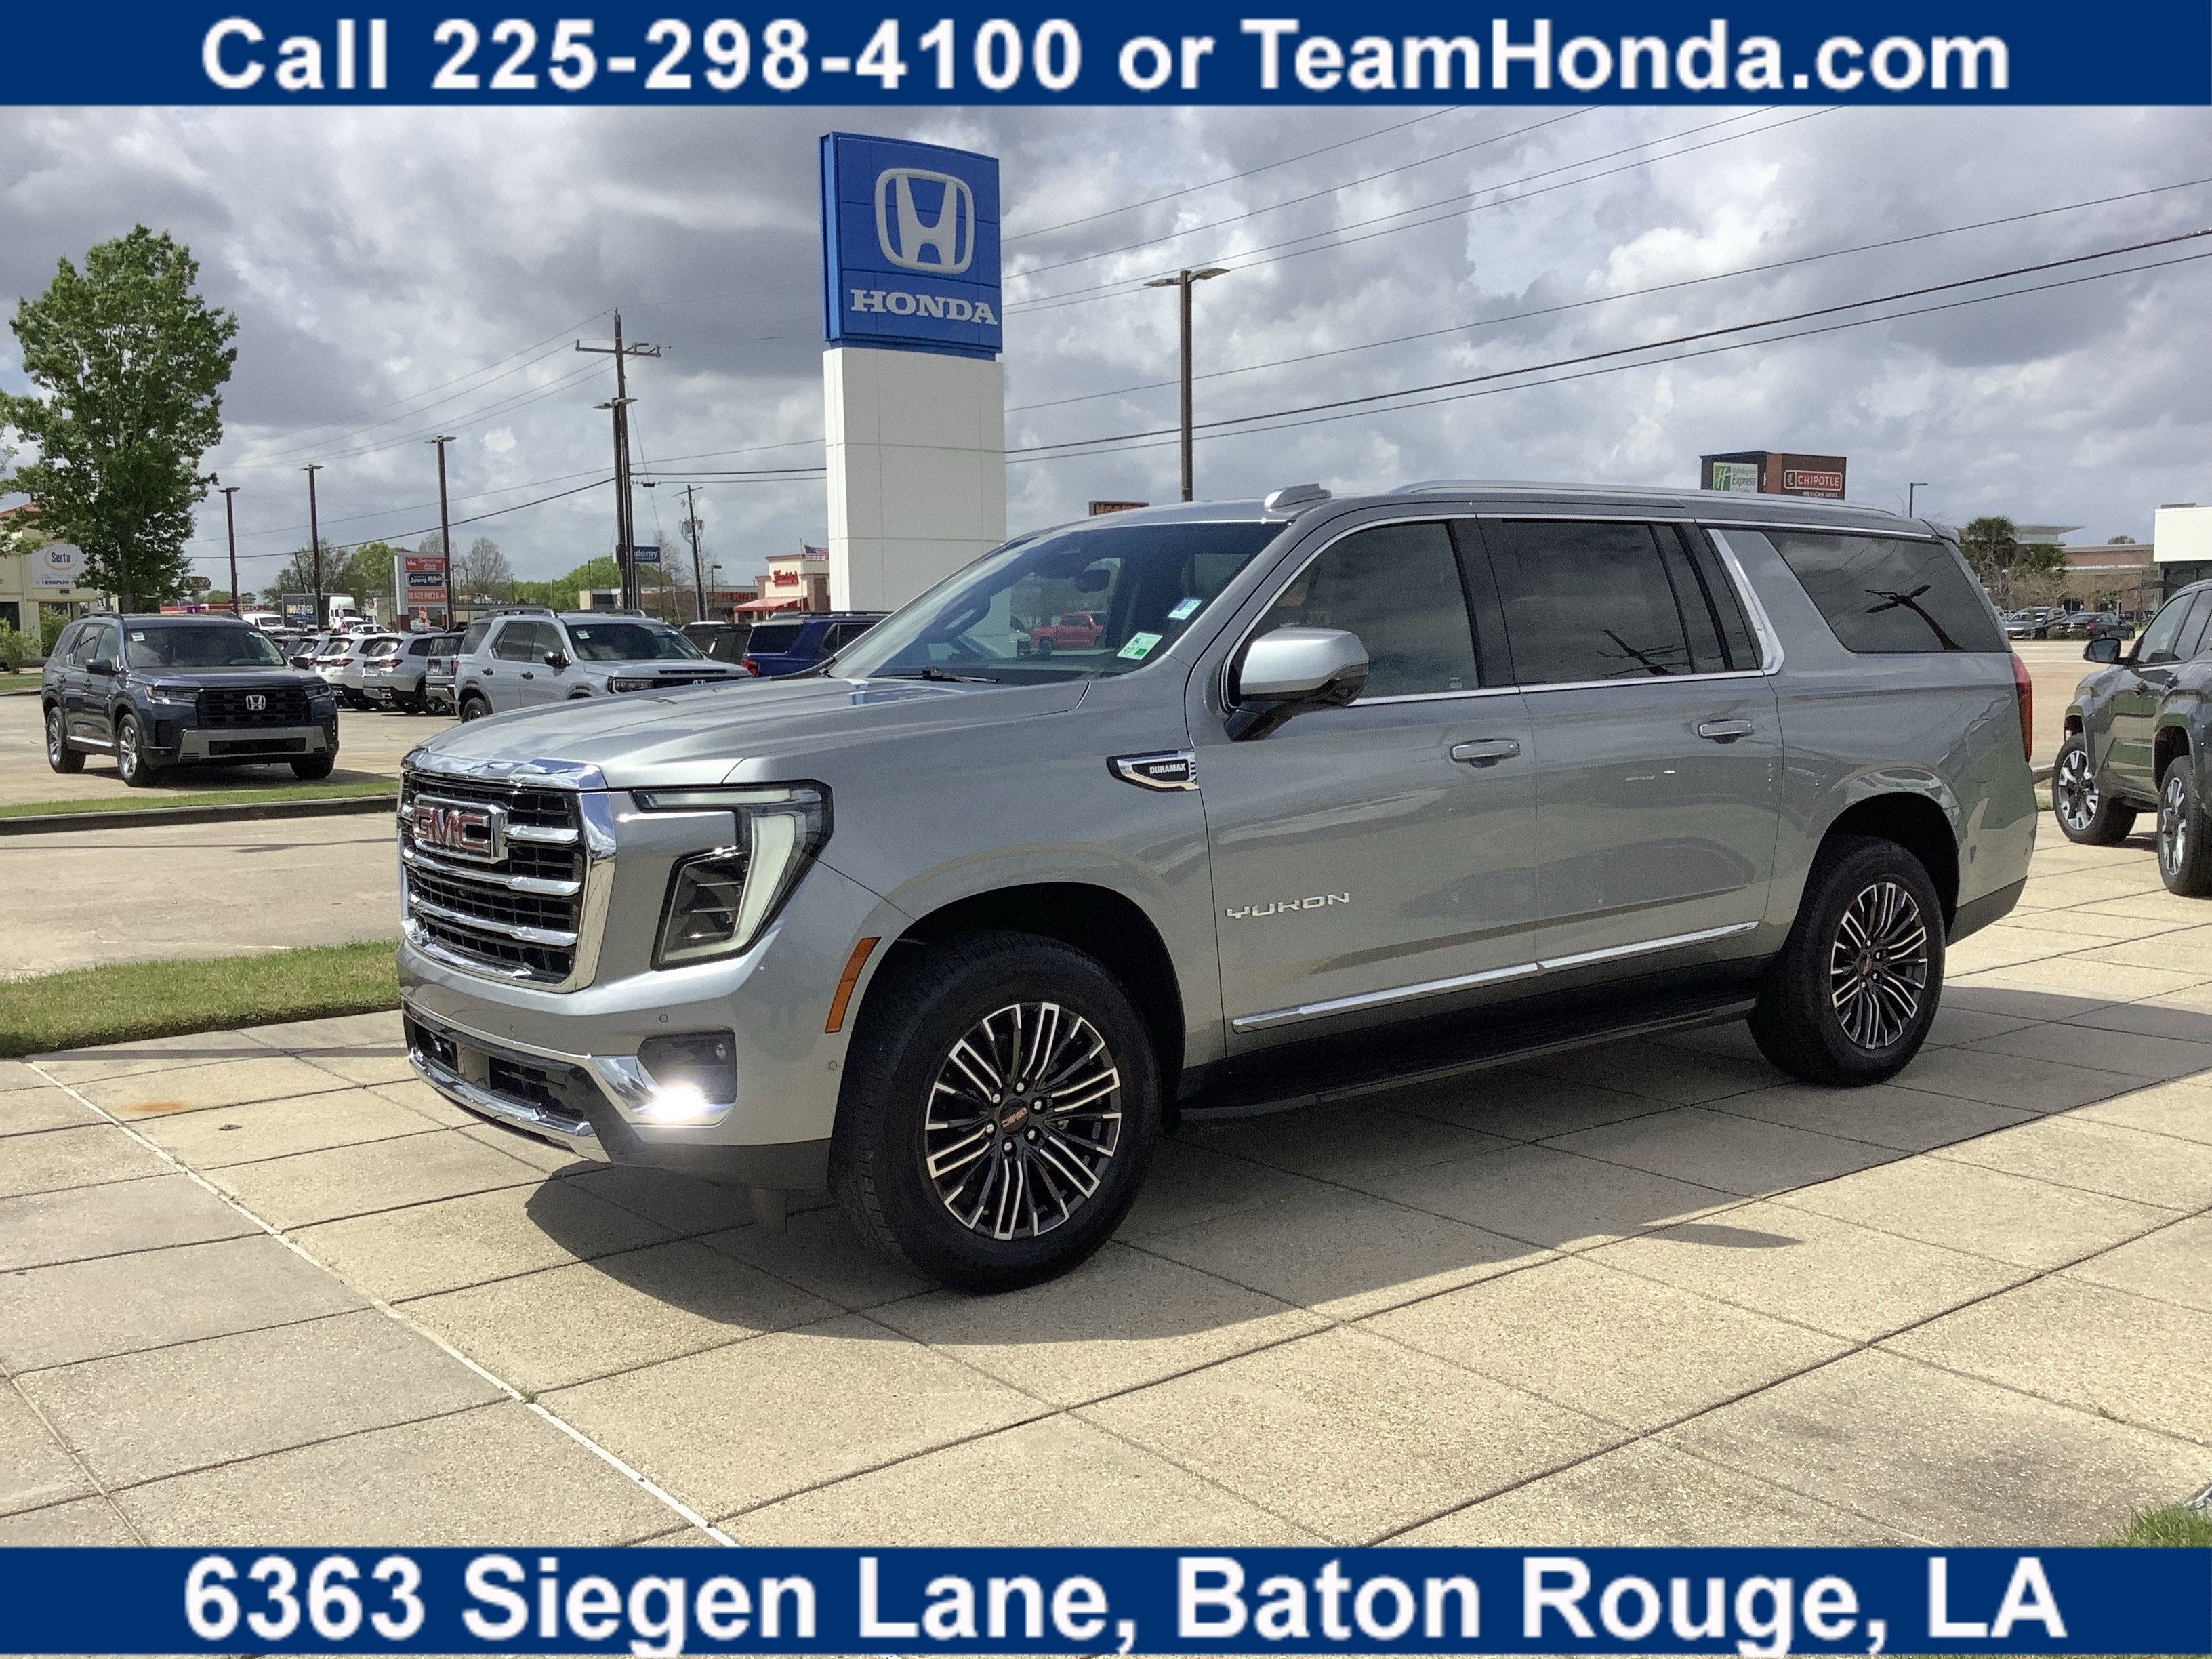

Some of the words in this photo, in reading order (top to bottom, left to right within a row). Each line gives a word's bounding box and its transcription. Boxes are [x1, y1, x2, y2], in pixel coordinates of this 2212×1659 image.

[850, 289, 998, 325] HONDA
[1732, 475, 1756, 487] Express
[1798, 475, 1839, 487] CHIPOTLE
[51, 552, 71, 563] Serta
[1149, 763, 1186, 774] DURAMAX
[413, 806, 491, 853] GMC
[1226, 892, 1349, 919] YUKON
